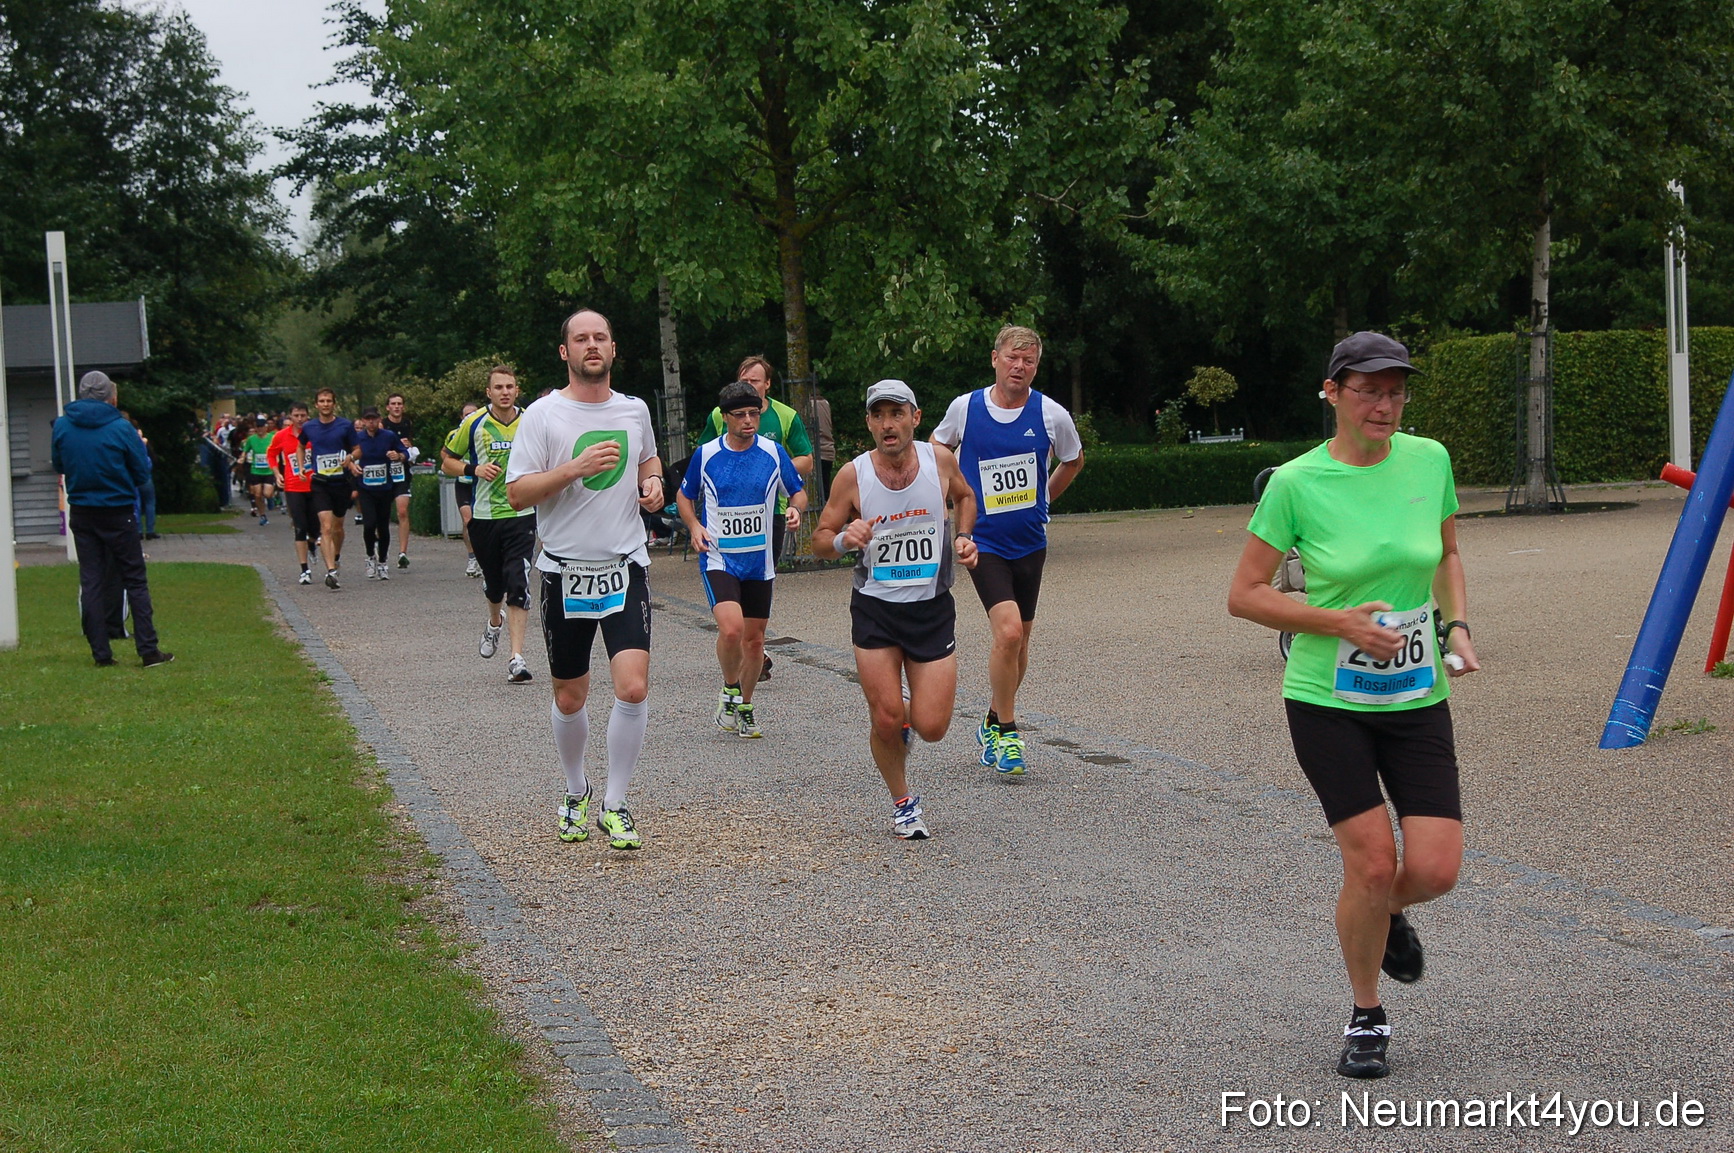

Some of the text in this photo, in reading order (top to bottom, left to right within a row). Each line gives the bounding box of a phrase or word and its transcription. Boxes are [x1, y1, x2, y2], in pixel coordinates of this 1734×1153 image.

[491, 441, 512, 450] BO
[980, 459, 1027, 472] PARTL Neumarkt
[992, 468, 1028, 492] 309
[996, 492, 1029, 505] Winfried
[734, 509, 758, 517] Neumarkt
[889, 508, 931, 522] KLEBL
[722, 516, 762, 536] 3080
[894, 528, 926, 539] Neumarkt
[877, 537, 933, 564] 2700
[585, 563, 617, 572] Neumarkt
[890, 567, 922, 579] Roland
[568, 571, 624, 596] 2750
[590, 602, 605, 611] Jan
[1348, 629, 1424, 670] 206
[1353, 675, 1416, 692] Rosalinde
